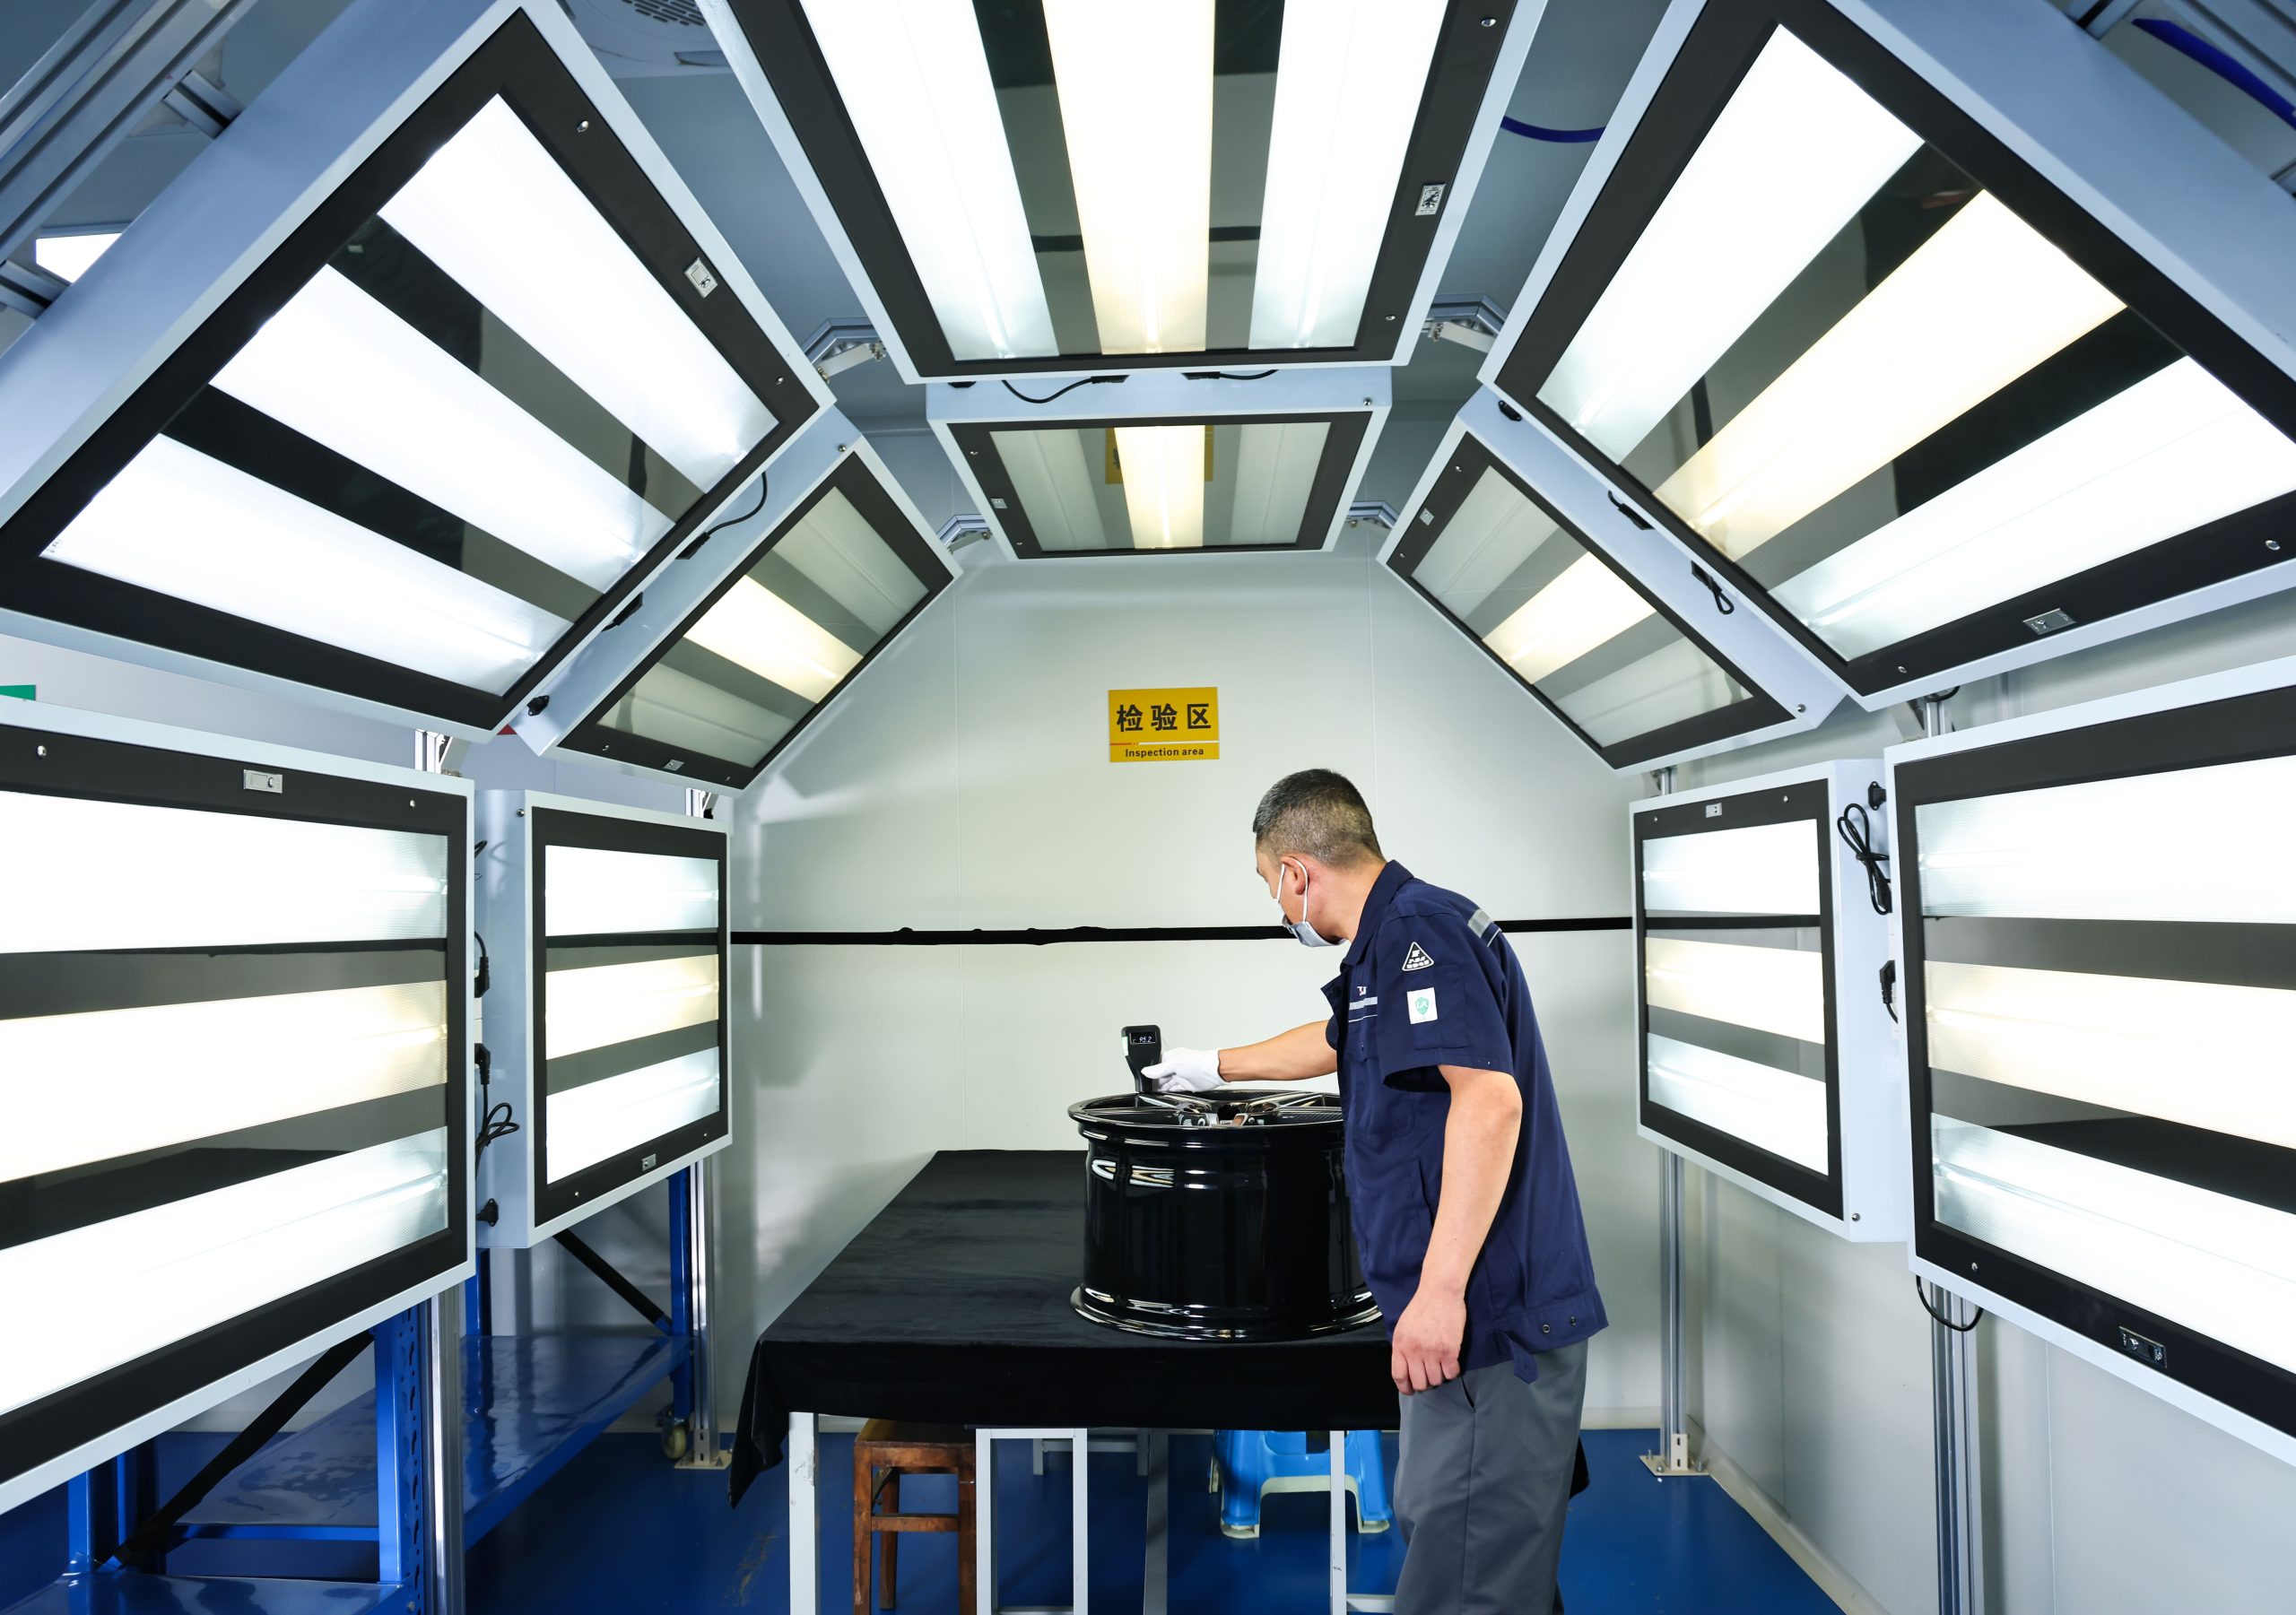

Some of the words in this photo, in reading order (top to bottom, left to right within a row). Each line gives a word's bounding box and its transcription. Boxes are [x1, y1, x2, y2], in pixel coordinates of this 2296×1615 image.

[1117, 703, 1211, 732] 检验区
[1126, 748, 1179, 759] Inspection
[1182, 748, 1204, 756] area
